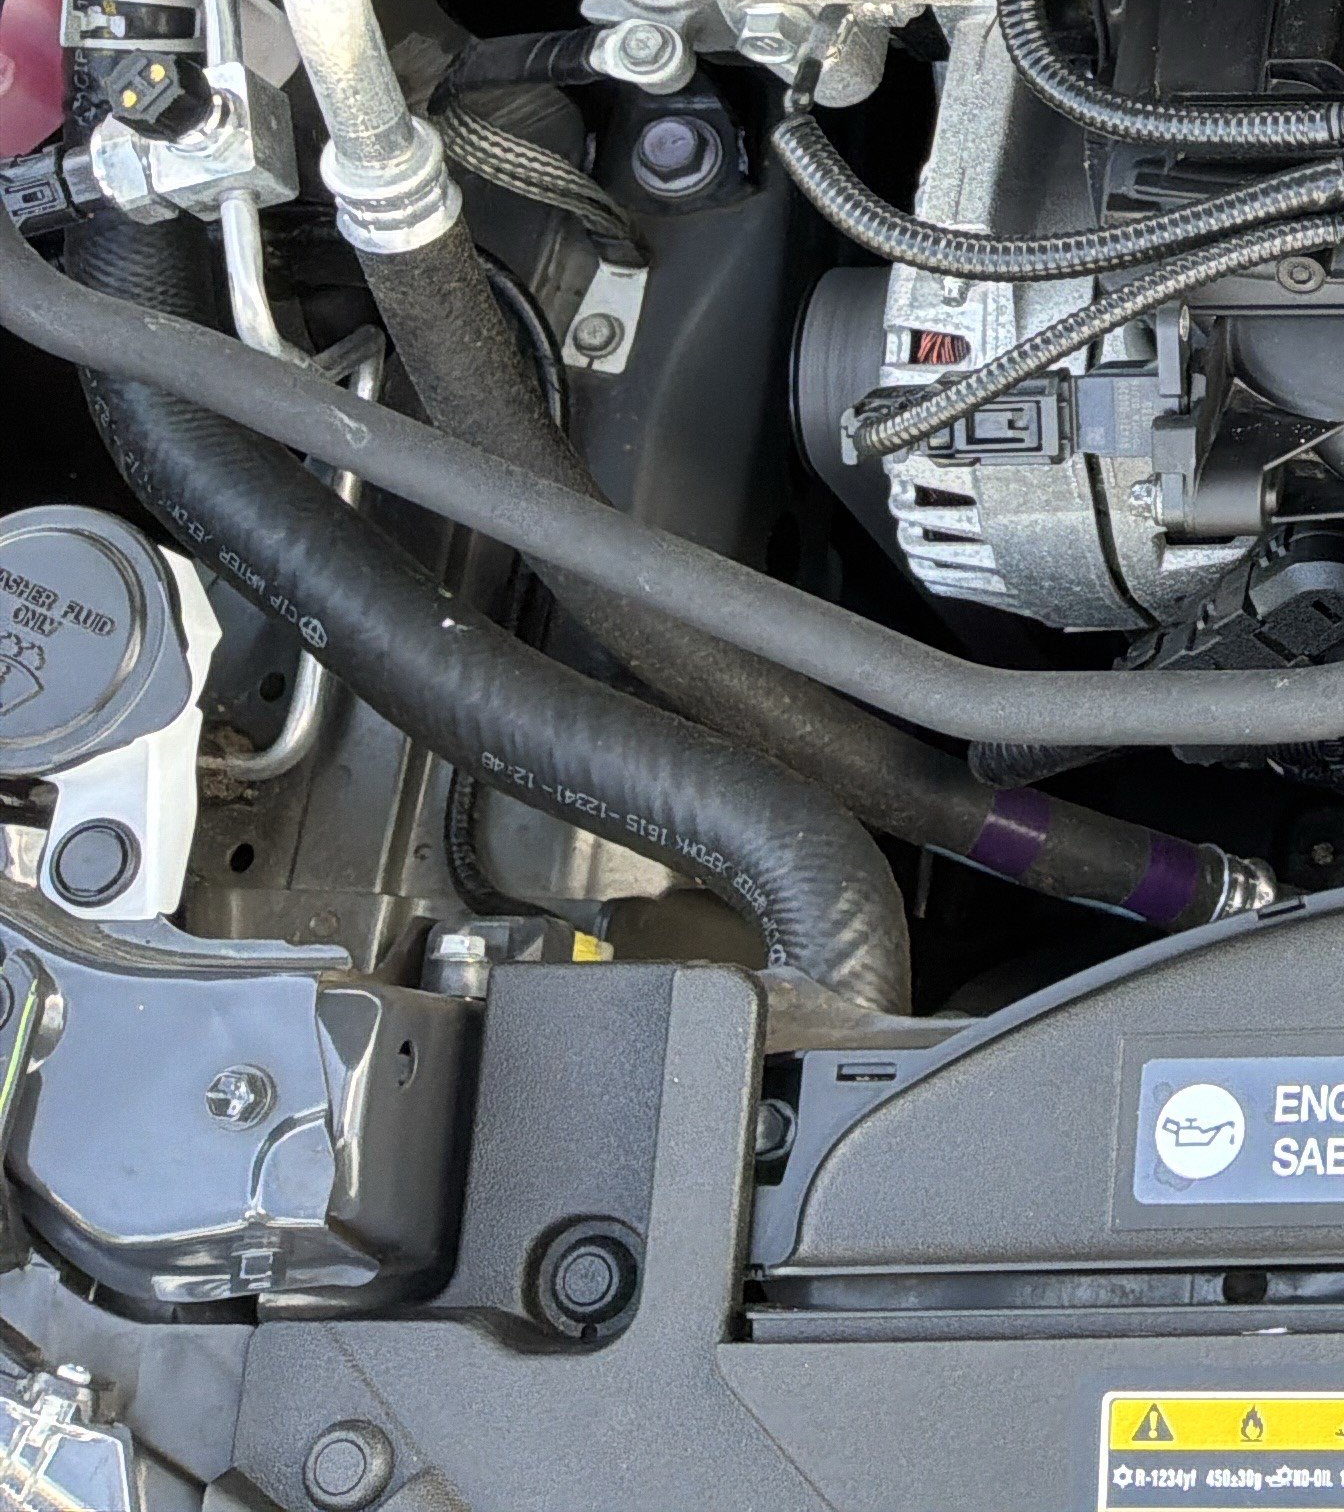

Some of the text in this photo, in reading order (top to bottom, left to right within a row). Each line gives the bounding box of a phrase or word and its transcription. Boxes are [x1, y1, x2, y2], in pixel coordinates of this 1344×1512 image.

[218, 544, 267, 596] WATER
[0, 567, 117, 637] ASHER FLUID
[269, 594, 298, 624] CIP
[12, 603, 63, 638] ONLY
[625, 814, 668, 846] 1615
[1133, 1468, 1198, 1492] R-1234yf
[1205, 1468, 1263, 1492] 450±30g
